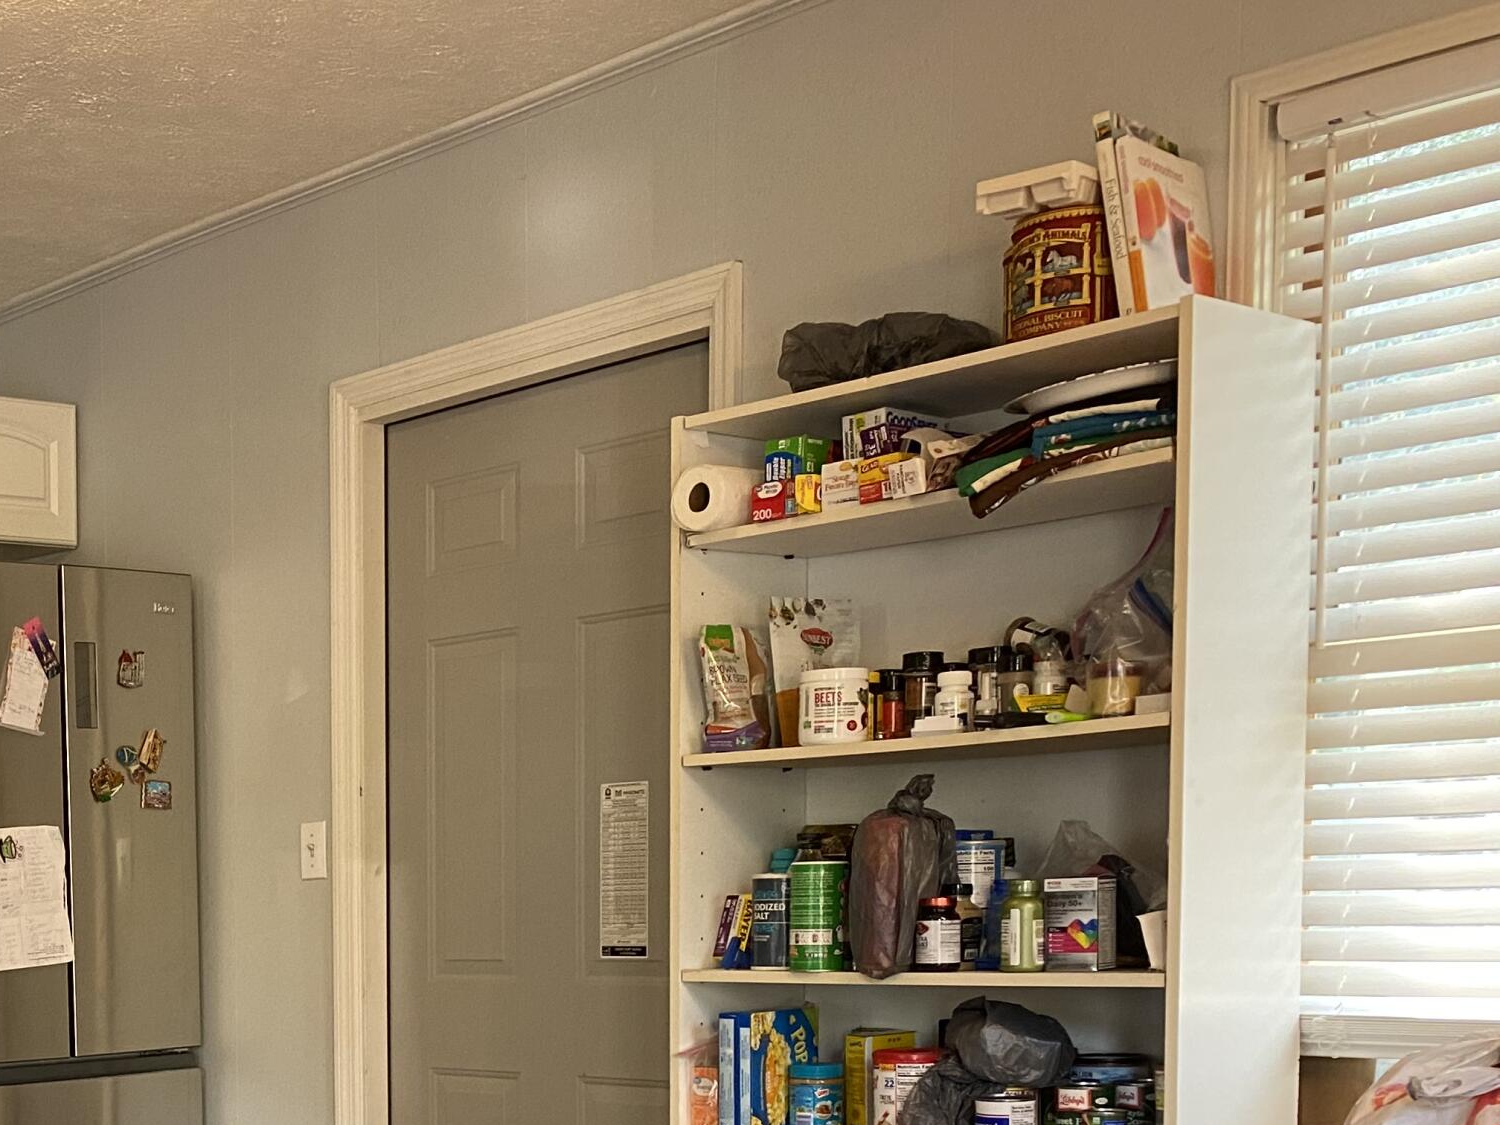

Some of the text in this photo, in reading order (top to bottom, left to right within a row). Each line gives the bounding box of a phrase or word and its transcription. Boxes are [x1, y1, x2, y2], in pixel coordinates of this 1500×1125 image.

[753, 508, 772, 521] 200
[814, 691, 842, 704] BEETS
[754, 903, 786, 911] ODIZED
[885, 1080, 894, 1088] 22
